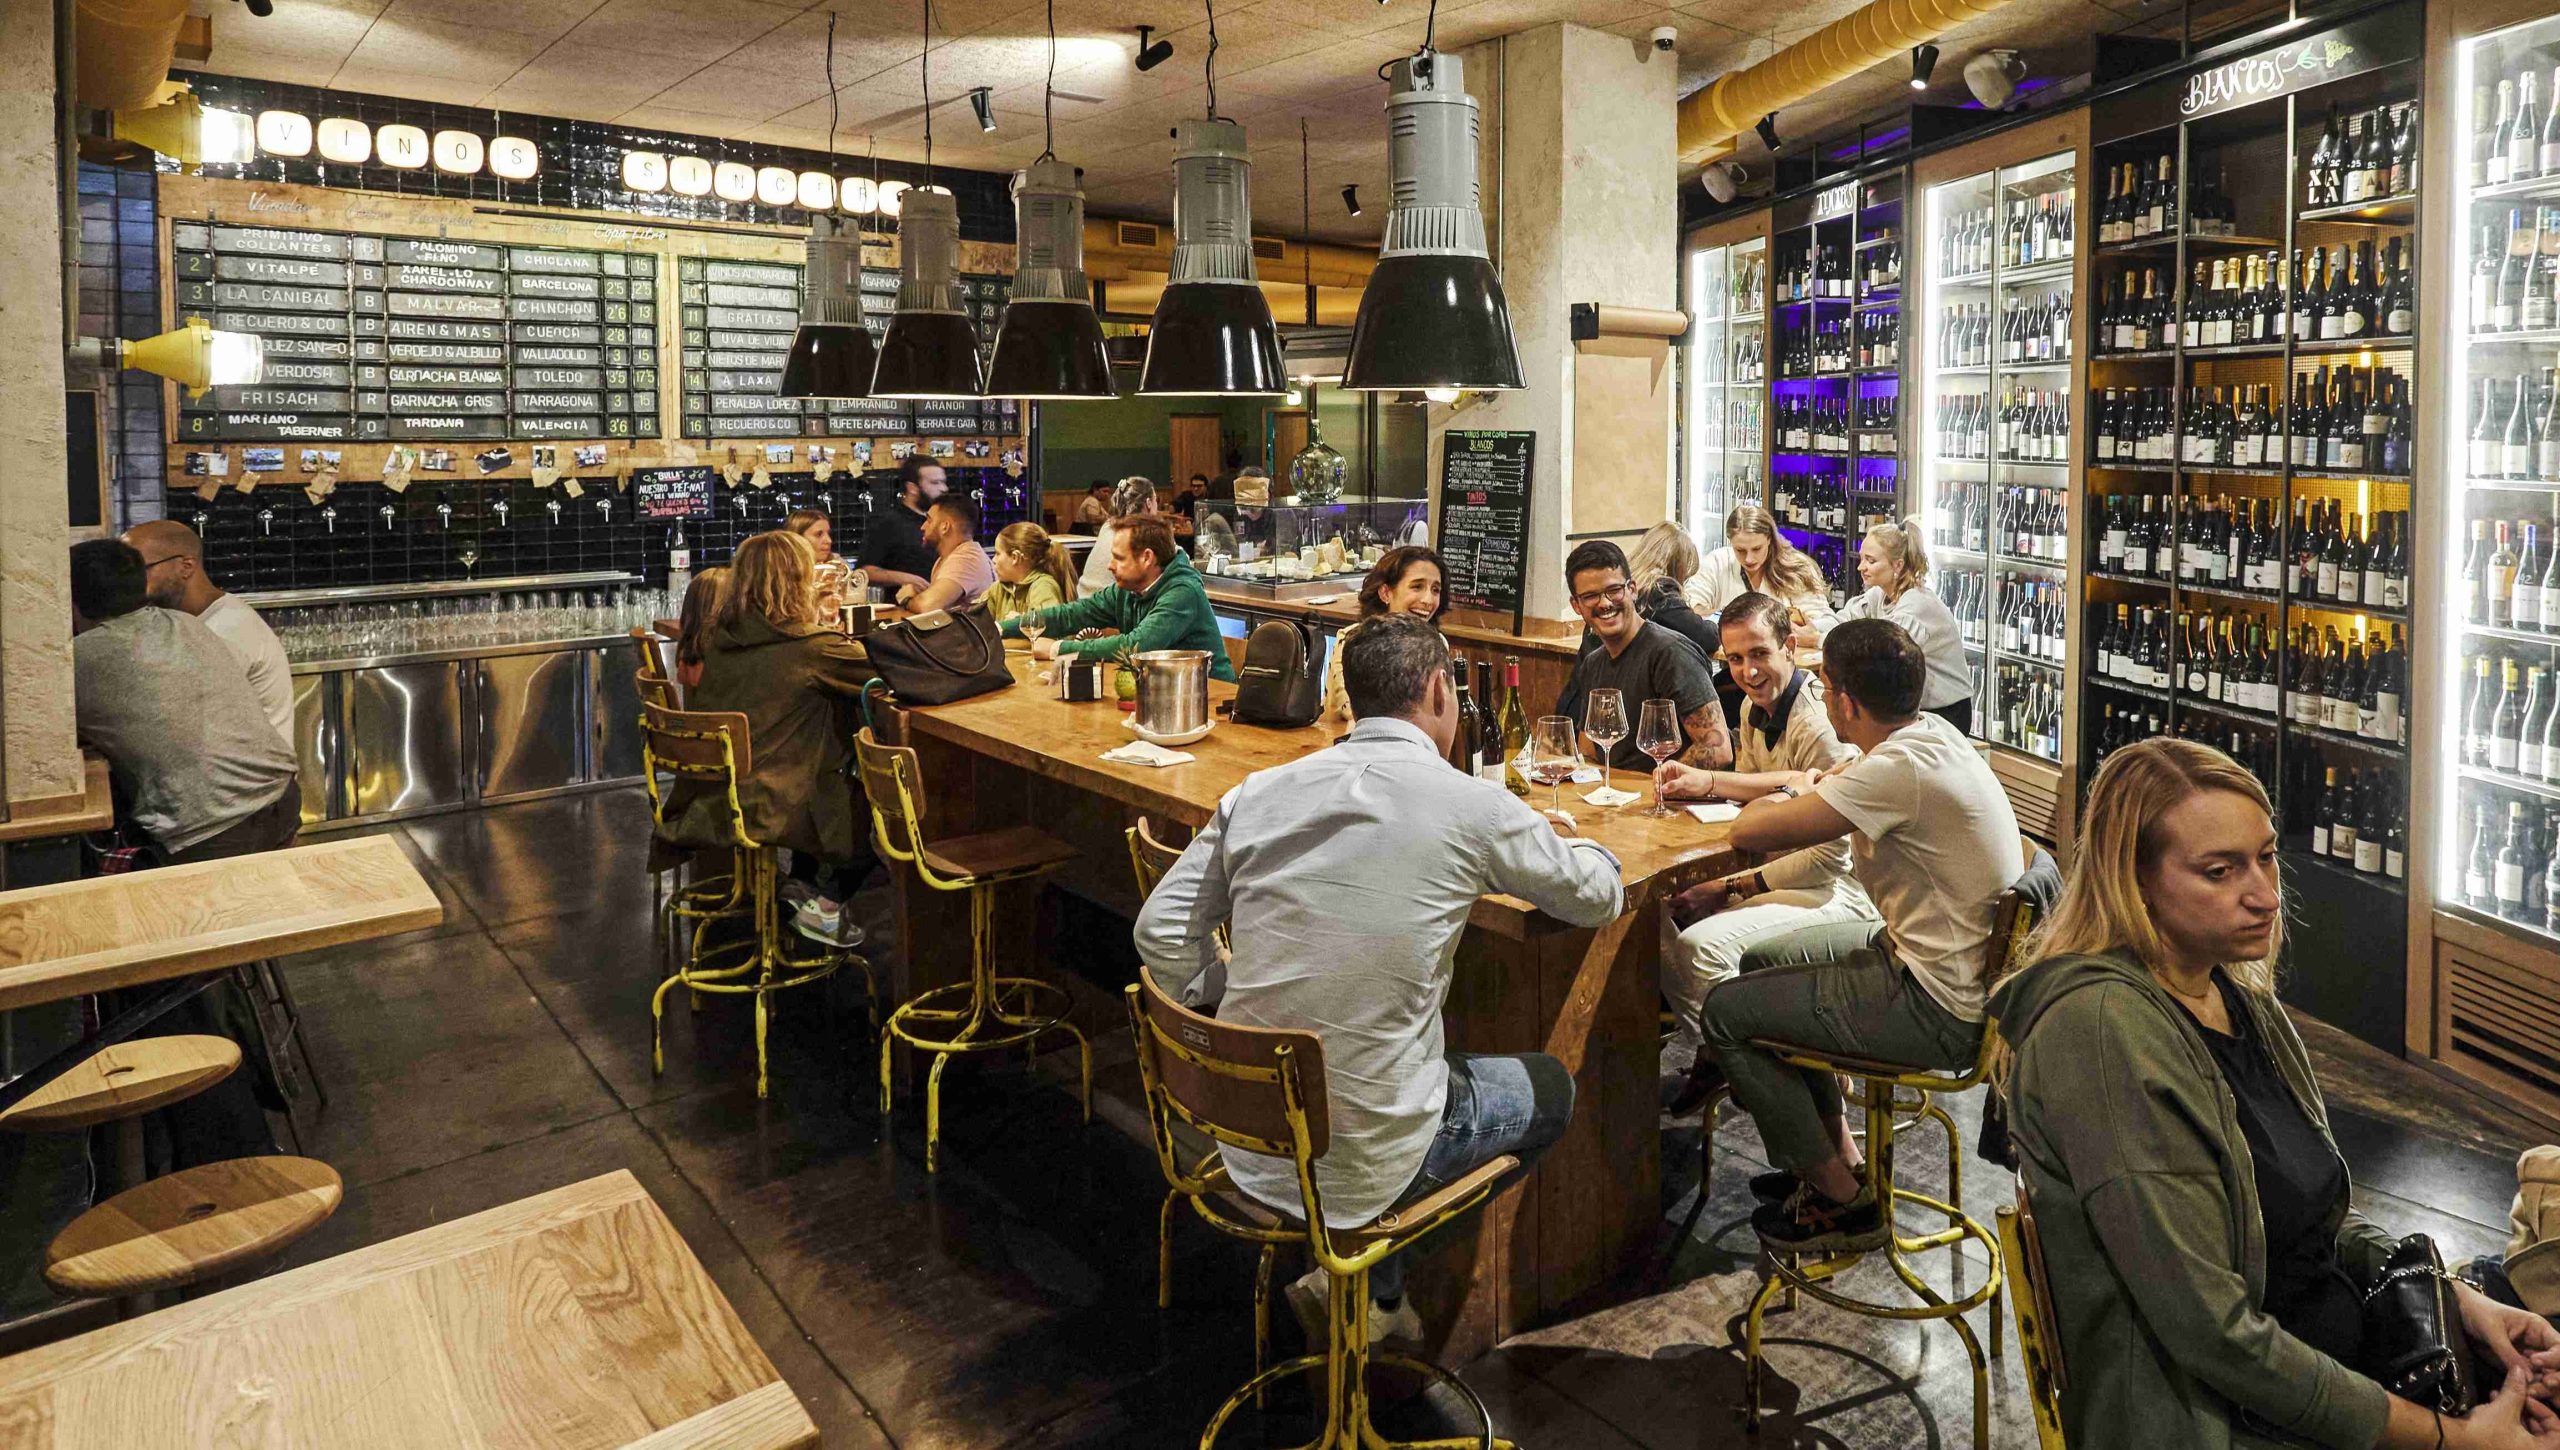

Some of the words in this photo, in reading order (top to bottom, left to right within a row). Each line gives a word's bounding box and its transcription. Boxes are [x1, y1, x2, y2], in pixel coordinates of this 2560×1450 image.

[2180, 50, 2292, 114] BLANCOS
[280, 123, 523, 165] VINOS
[242, 228, 324, 243] PRIMITIVO
[235, 240, 332, 253] COLLANTES
[409, 241, 477, 254] PALOMINO
[424, 252, 458, 263] FINO
[524, 255, 590, 268] CHICLANA
[189, 256, 200, 272] 2
[634, 259, 648, 272] 15
[686, 262, 694, 274] 9
[363, 269, 373, 280] B
[400, 275, 494, 290] CHARDONNAY
[522, 278, 593, 292] BARCELONA
[192, 285, 203, 300] 3
[226, 288, 249, 300] LA
[261, 289, 334, 305] CANIBAL
[365, 295, 375, 307] B
[518, 301, 592, 314] CHINCHON
[639, 306, 650, 318] 13
[688, 310, 698, 322] 11
[727, 311, 783, 325] GRATIAS
[226, 314, 298, 329] RECUERO
[301, 316, 310, 329] &
[316, 317, 336, 331] CO
[365, 318, 375, 330] B
[391, 322, 436, 336] AIREN
[439, 324, 449, 336] &
[455, 326, 492, 338] MAS
[638, 329, 649, 341] 14
[688, 331, 700, 343] 12
[721, 333, 744, 344] UVA
[748, 335, 761, 345] DE
[764, 336, 785, 346] VIDA
[365, 343, 375, 354] B
[389, 343, 442, 357] VERDEJO
[445, 347, 455, 358] &
[455, 347, 502, 359] ALBILLO
[522, 348, 587, 361] VALLADOLID
[613, 350, 621, 361] 3
[638, 349, 649, 361] 15
[745, 355, 758, 365] DE
[365, 367, 375, 379] B
[389, 369, 457, 383] GARNACHA
[534, 371, 583, 383] TOLEDO
[689, 375, 700, 386] 14
[723, 375, 731, 386] A
[241, 391, 318, 405] FRISACH
[367, 392, 376, 405] R
[391, 395, 458, 407] GARNACHA
[465, 395, 493, 407] GRIS
[522, 395, 593, 407] TARRAGONA
[614, 395, 622, 407] 3
[639, 395, 650, 406] 15
[689, 398, 700, 410] 15
[766, 399, 797, 410] LOPEZ
[924, 400, 965, 410] ARANDA
[192, 417, 203, 432] 8
[640, 419, 651, 431] 18
[690, 420, 702, 432] 16
[719, 420, 767, 429] RECUERO
[777, 420, 791, 429] CO
[811, 420, 817, 430] T
[829, 419, 863, 429] RUFETE
[863, 419, 871, 429] &
[916, 418, 945, 428] SIERRA
[945, 418, 956, 428] DE
[957, 418, 976, 428] GATA
[277, 426, 343, 437] TABERNER
[639, 484, 669, 495] NUESTRO
